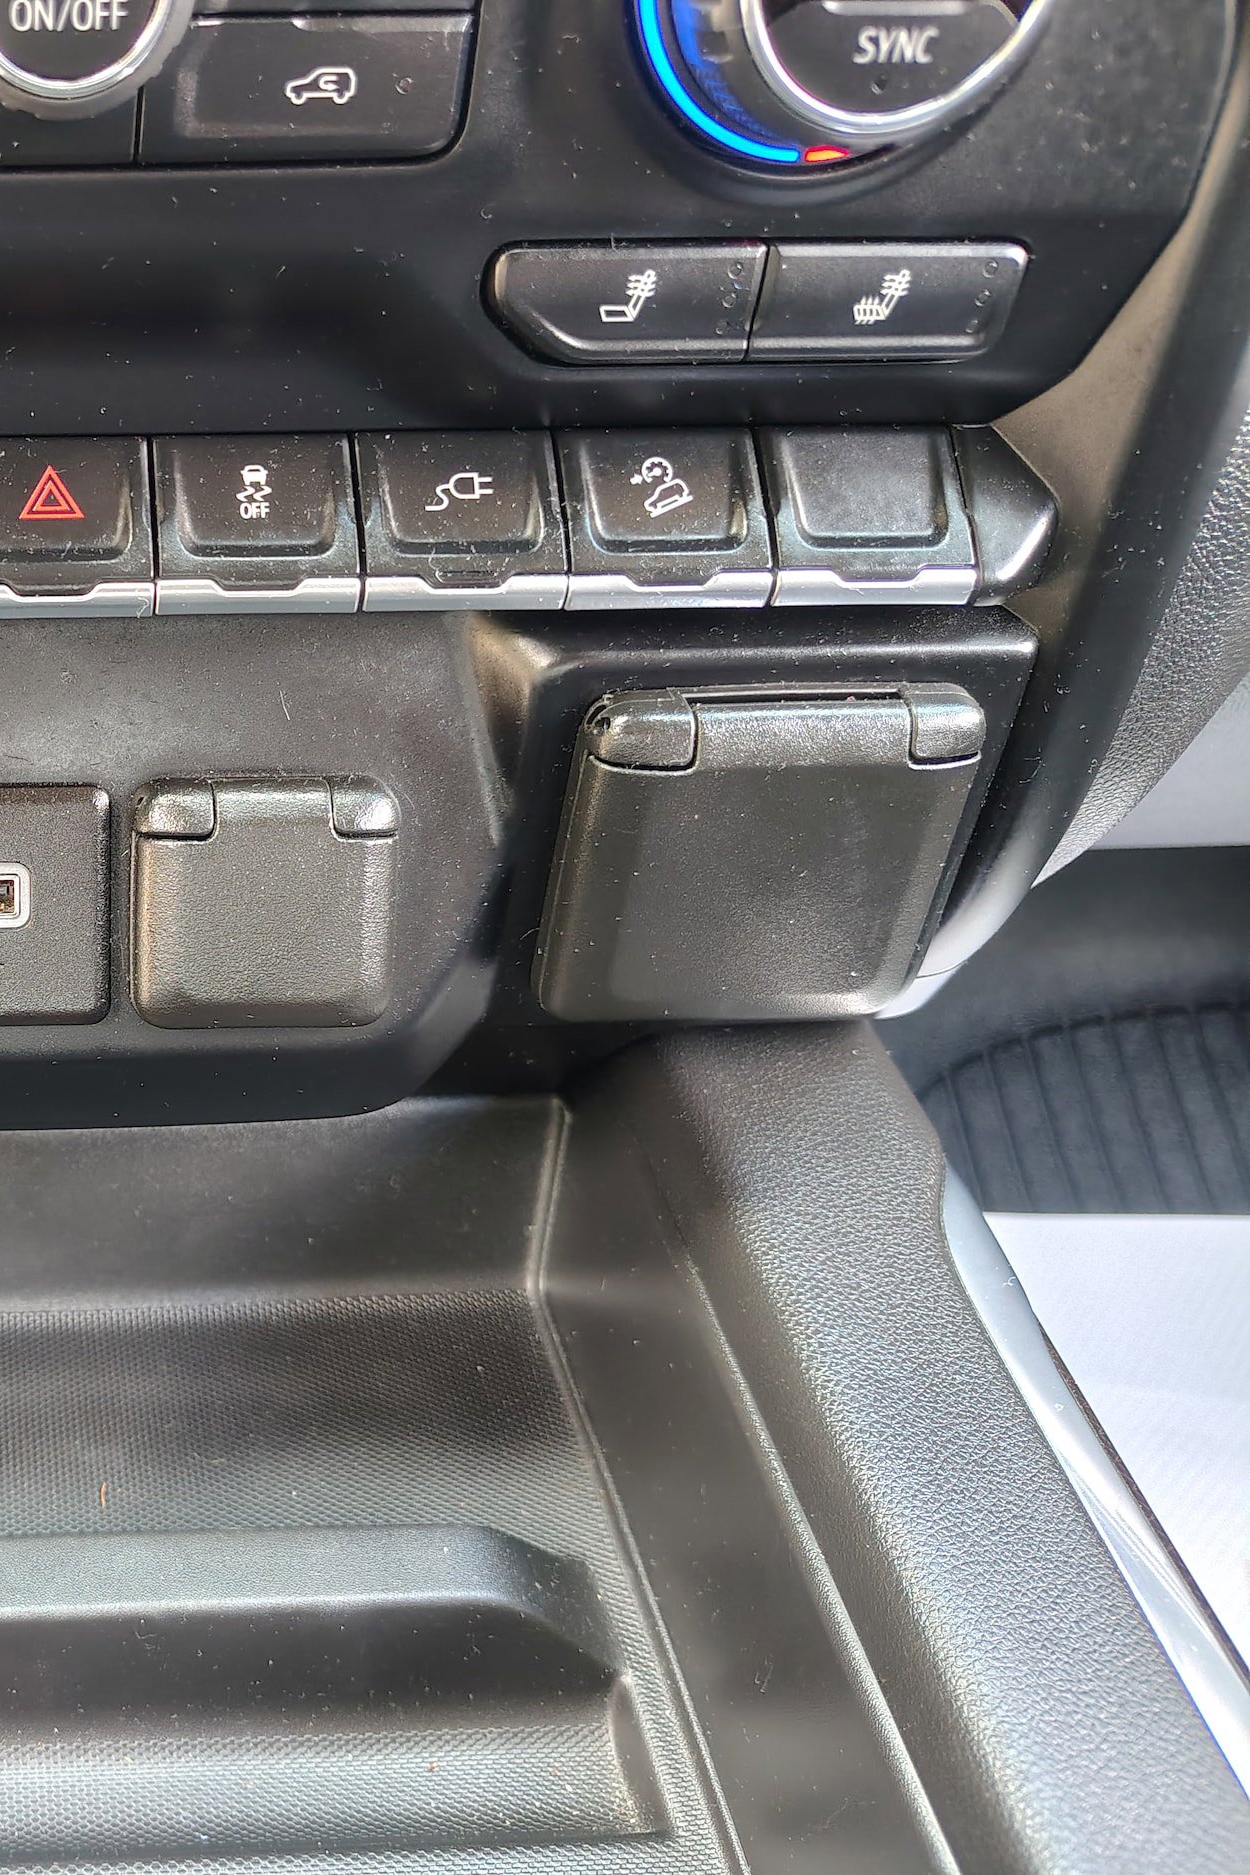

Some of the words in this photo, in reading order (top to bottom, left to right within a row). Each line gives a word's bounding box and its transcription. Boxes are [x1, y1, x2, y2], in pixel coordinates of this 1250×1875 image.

[9, 0, 129, 32] ON/OFF
[852, 25, 940, 64] SYNC
[239, 502, 270, 519] OFF
